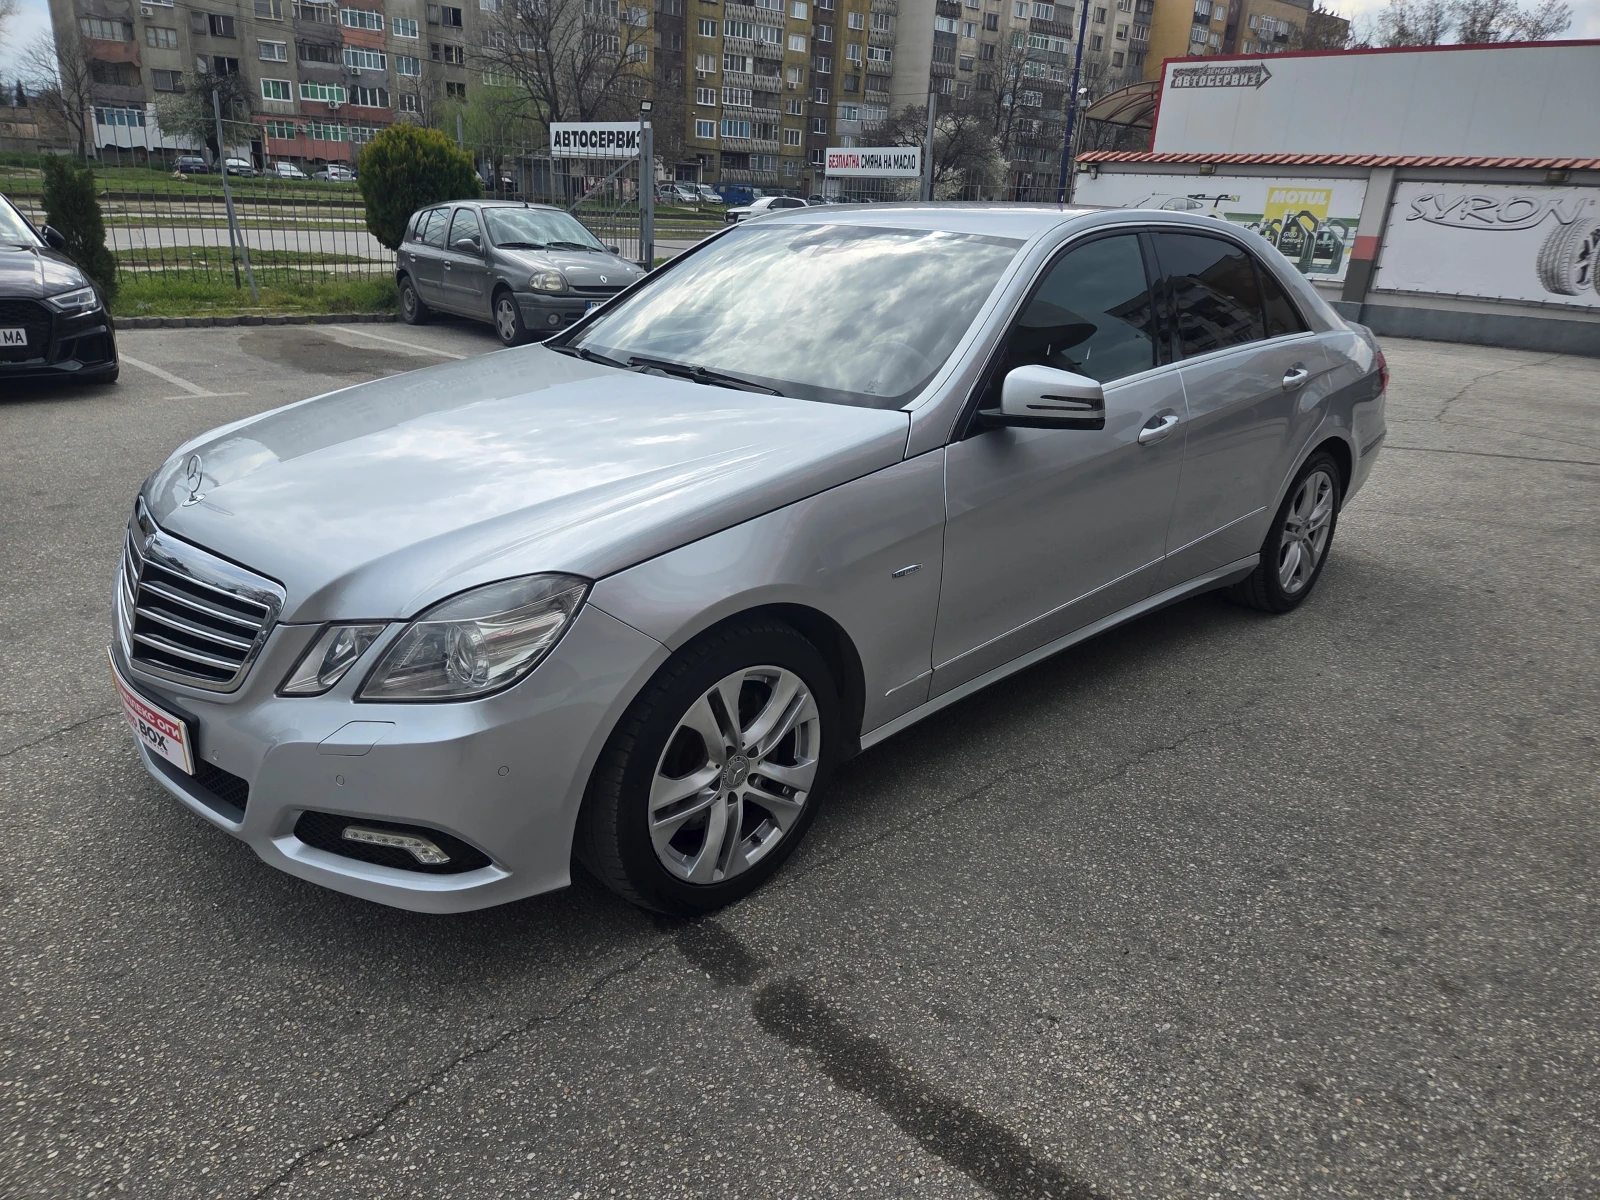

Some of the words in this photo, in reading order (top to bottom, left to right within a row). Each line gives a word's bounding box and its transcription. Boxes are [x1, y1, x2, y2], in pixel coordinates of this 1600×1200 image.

[1173, 73, 1257, 88] АВТОСЕРВИЗ
[828, 154, 860, 169] БЕЗПЛАТНА
[861, 154, 882, 170] СМЯНА
[883, 154, 892, 170] НА
[893, 154, 916, 170] МАСЛО
[1269, 190, 1328, 206] MOTUL
[1405, 194, 1587, 231] SYRON
[138, 718, 169, 752] BOX
[156, 719, 182, 740] ОГИ
